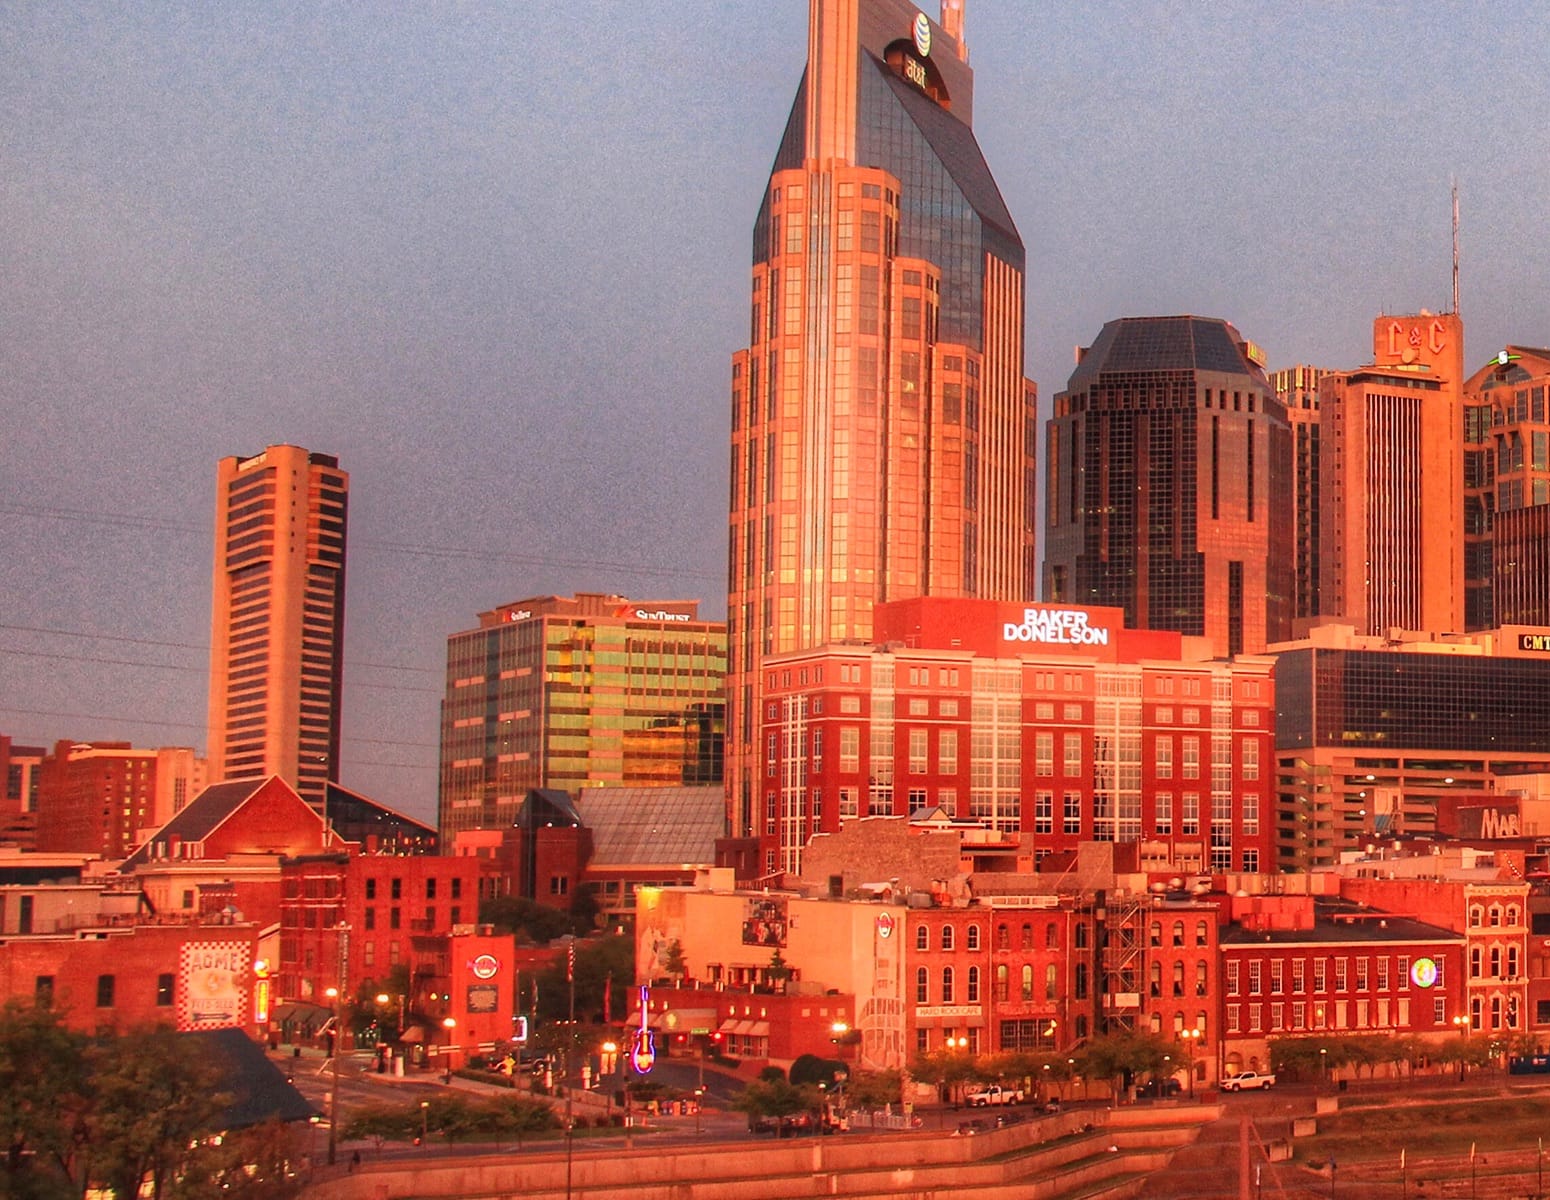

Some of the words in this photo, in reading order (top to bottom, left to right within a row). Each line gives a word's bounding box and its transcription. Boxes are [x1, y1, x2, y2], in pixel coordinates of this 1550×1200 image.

[1024, 609, 1088, 628] BAKER
[1003, 623, 1108, 645] DONELSON
[1481, 808, 1521, 839] MAR
[191, 953, 238, 973] ACME
